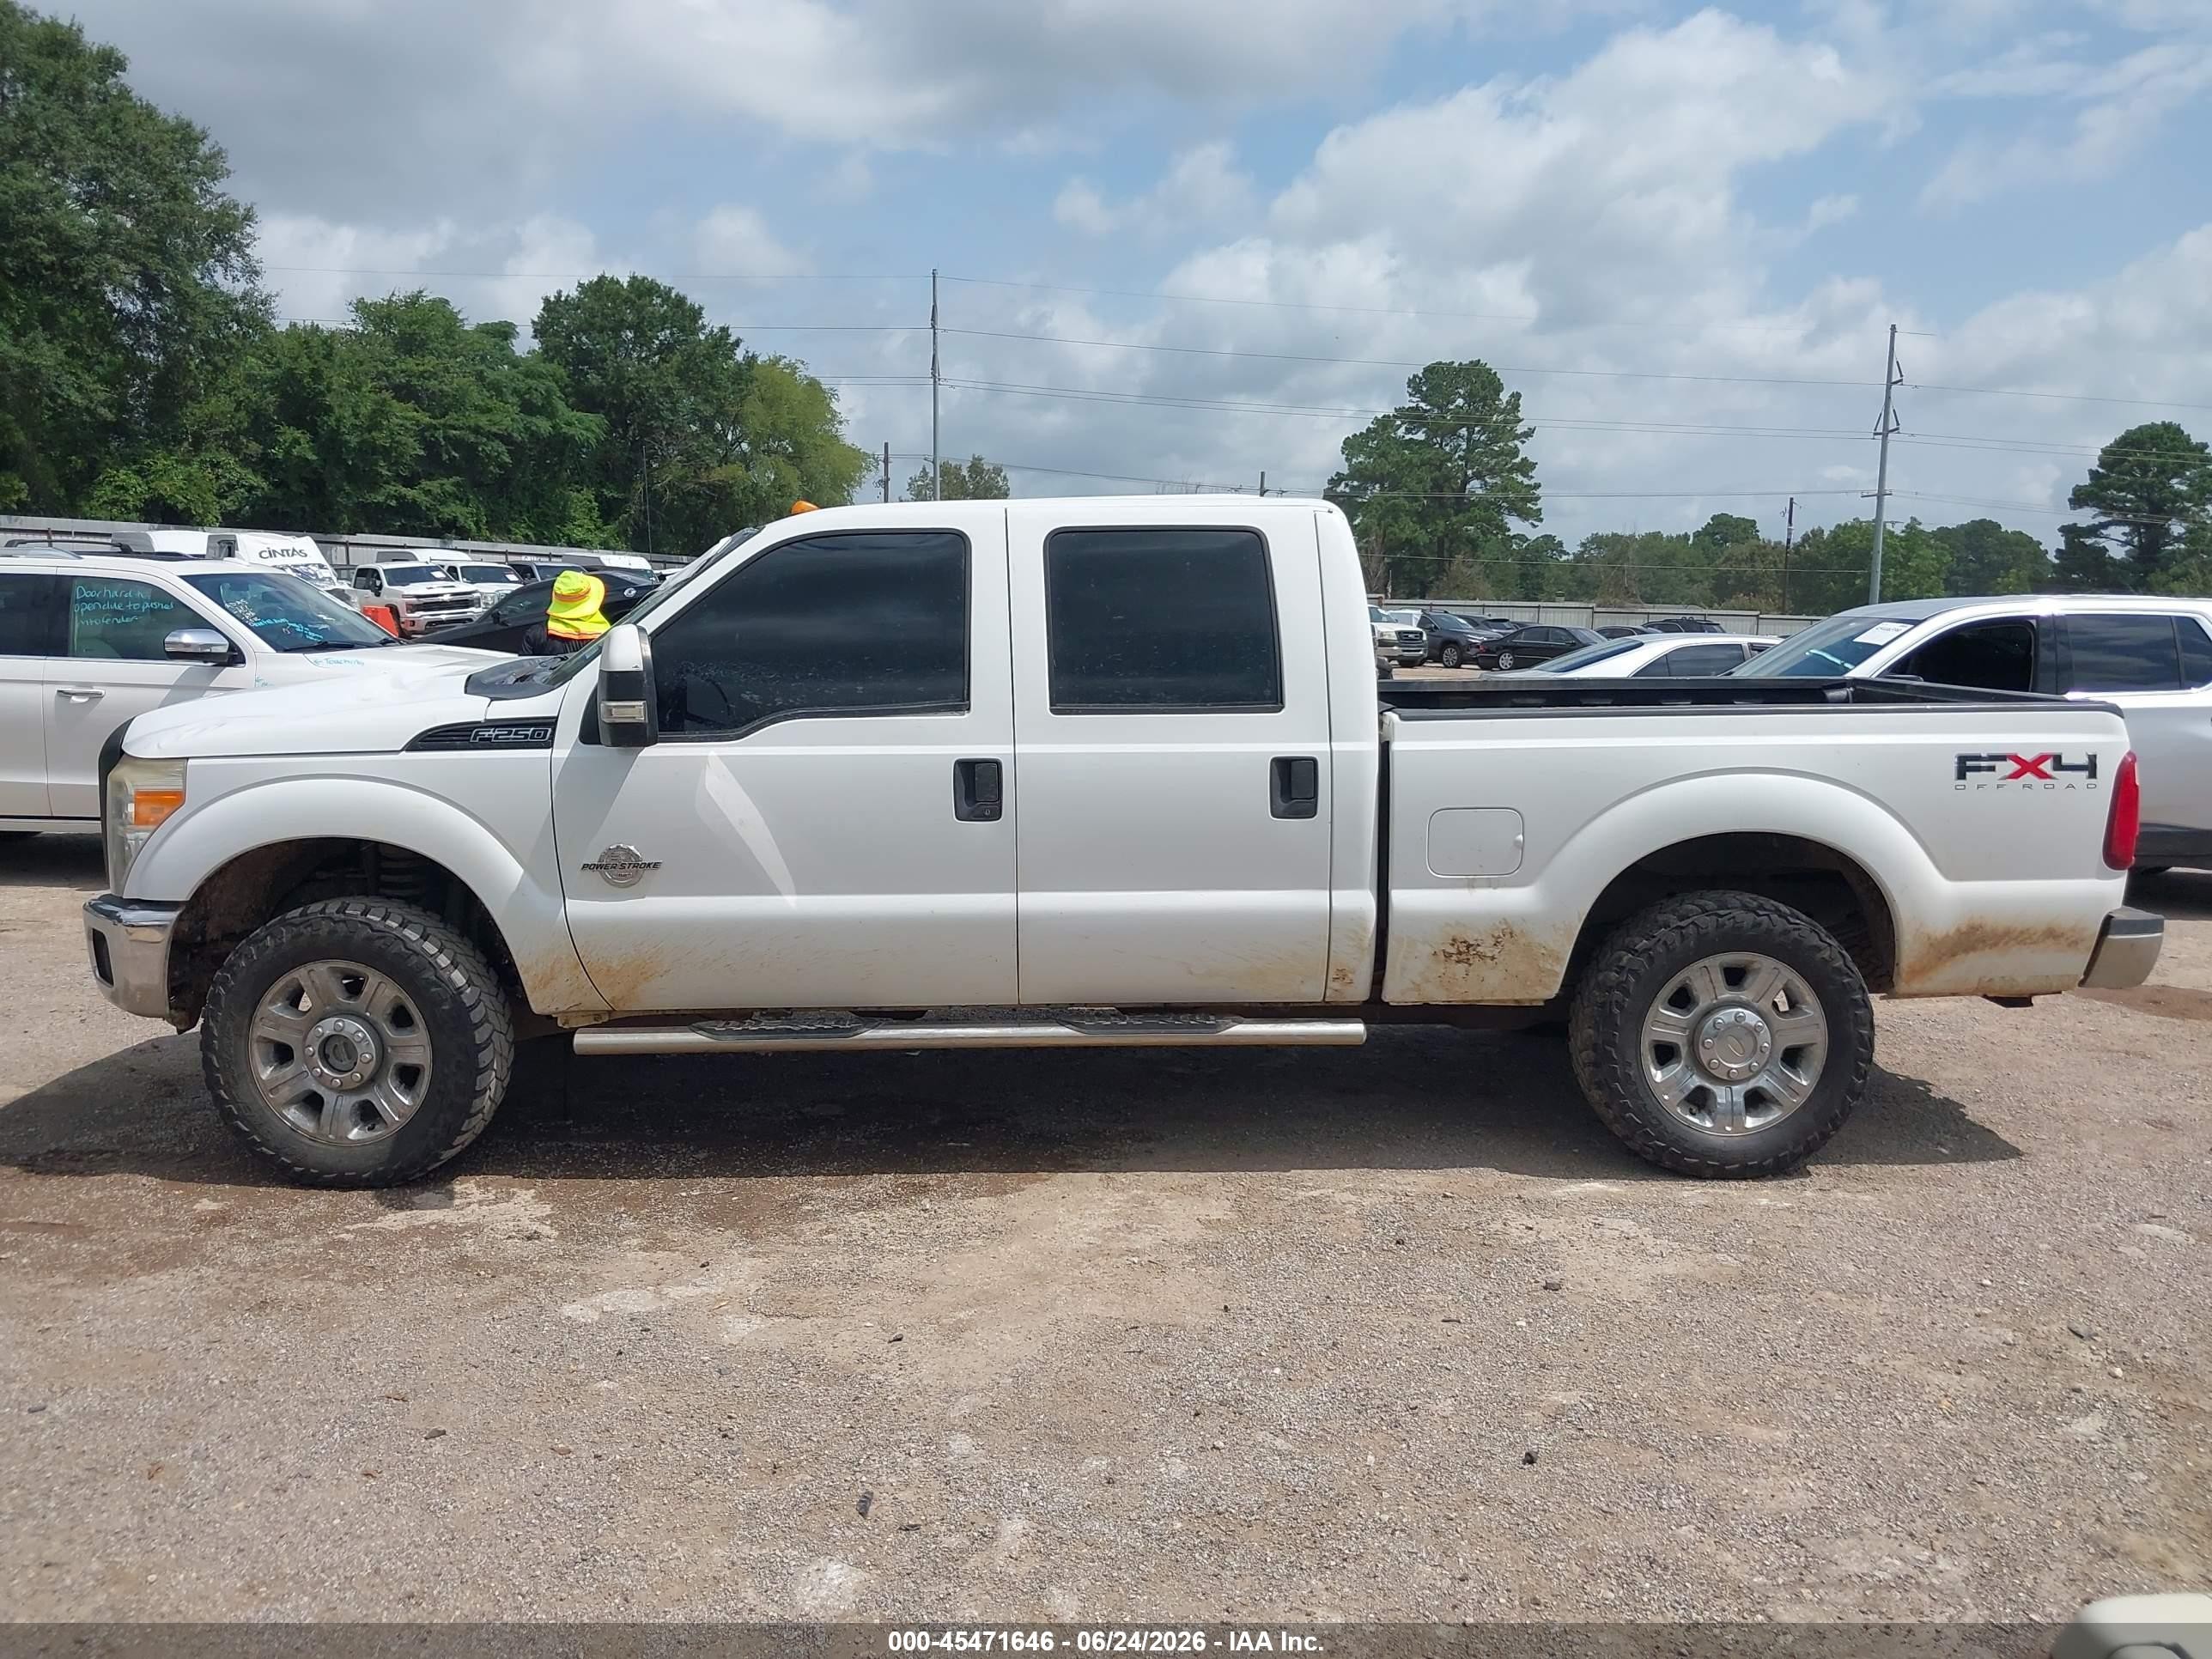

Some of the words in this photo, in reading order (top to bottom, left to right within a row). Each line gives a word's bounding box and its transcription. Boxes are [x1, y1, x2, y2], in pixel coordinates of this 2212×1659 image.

[1954, 752, 2098, 781] FX4
[581, 862, 618, 871] POWER
[618, 860, 663, 870] STROKE
